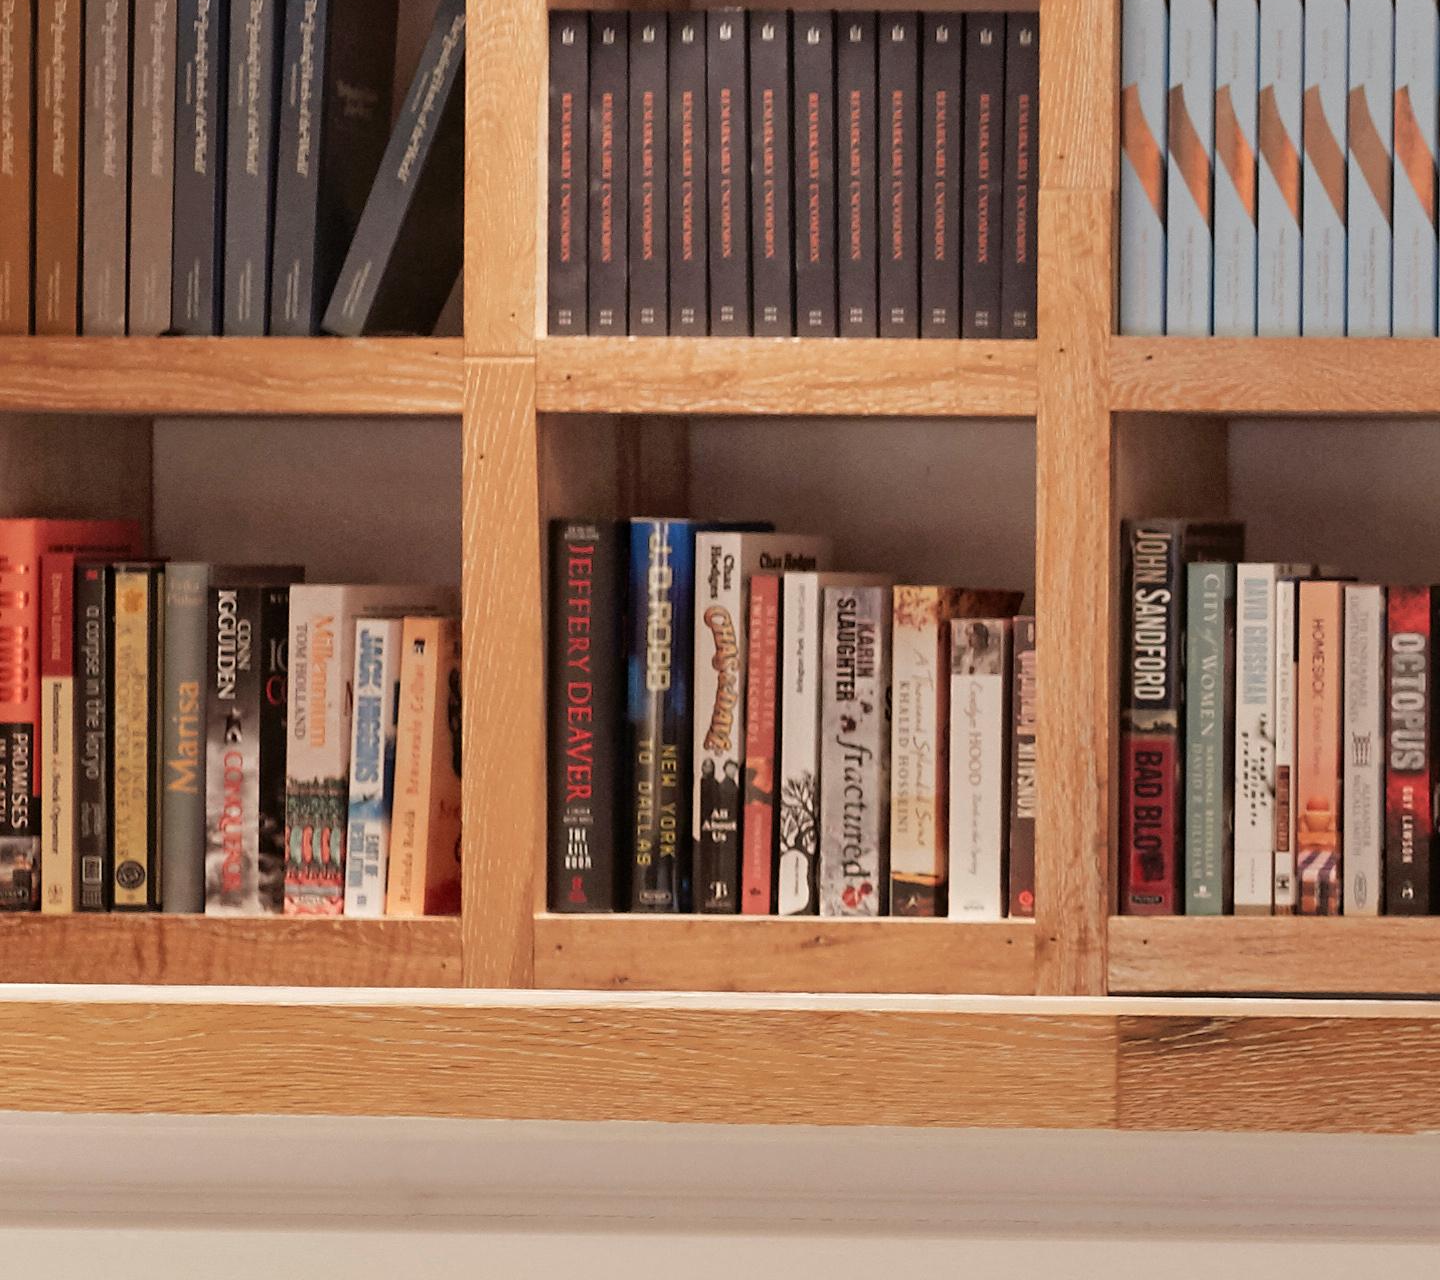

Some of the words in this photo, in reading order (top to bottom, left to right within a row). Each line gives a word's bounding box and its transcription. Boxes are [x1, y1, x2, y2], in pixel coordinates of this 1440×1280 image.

[708, 545, 722, 600] Hodges
[722, 554, 735, 590] Chas
[1135, 529, 1172, 585] JOHN
[567, 545, 594, 674] JEFFERY
[1201, 574, 1220, 626] CITY
[1243, 577, 1269, 621] DAVID
[84, 622, 100, 674] corpse
[217, 590, 237, 700] IGGULDEN
[237, 619, 251, 671] CONN
[296, 624, 308, 656] TOM
[358, 629, 384, 688] JACK
[646, 600, 672, 692] ROBB
[836, 598, 857, 702] SLAUGHTER
[857, 623, 875, 678] KARIN
[1134, 590, 1172, 701] SANDFORD
[1242, 624, 1268, 705] GROSSMAN
[1312, 619, 1326, 700] HOMESICK
[86, 697, 102, 727] the
[295, 660, 307, 741] HOLLAND
[898, 680, 910, 748] KHALED
[1200, 653, 1217, 737] WOMEN
[1390, 632, 1427, 770] OCTOPUS
[167, 681, 199, 793] Marisa
[354, 696, 382, 783] HIGGINS
[566, 682, 593, 803] DEAVER
[638, 738, 654, 764] TO
[661, 743, 676, 788] NEW
[969, 732, 982, 787] HOOD
[12, 731, 29, 829] PROMISES
[897, 754, 909, 833] HOSSEINI
[1134, 751, 1164, 799] BAD
[1402, 785, 1414, 810] GUY
[637, 781, 653, 866] DALLAS
[659, 801, 676, 858] YORK
[701, 819, 737, 831] About
[711, 808, 729, 820] All
[837, 734, 873, 878] fractured
[1401, 815, 1414, 864] LAWSON
